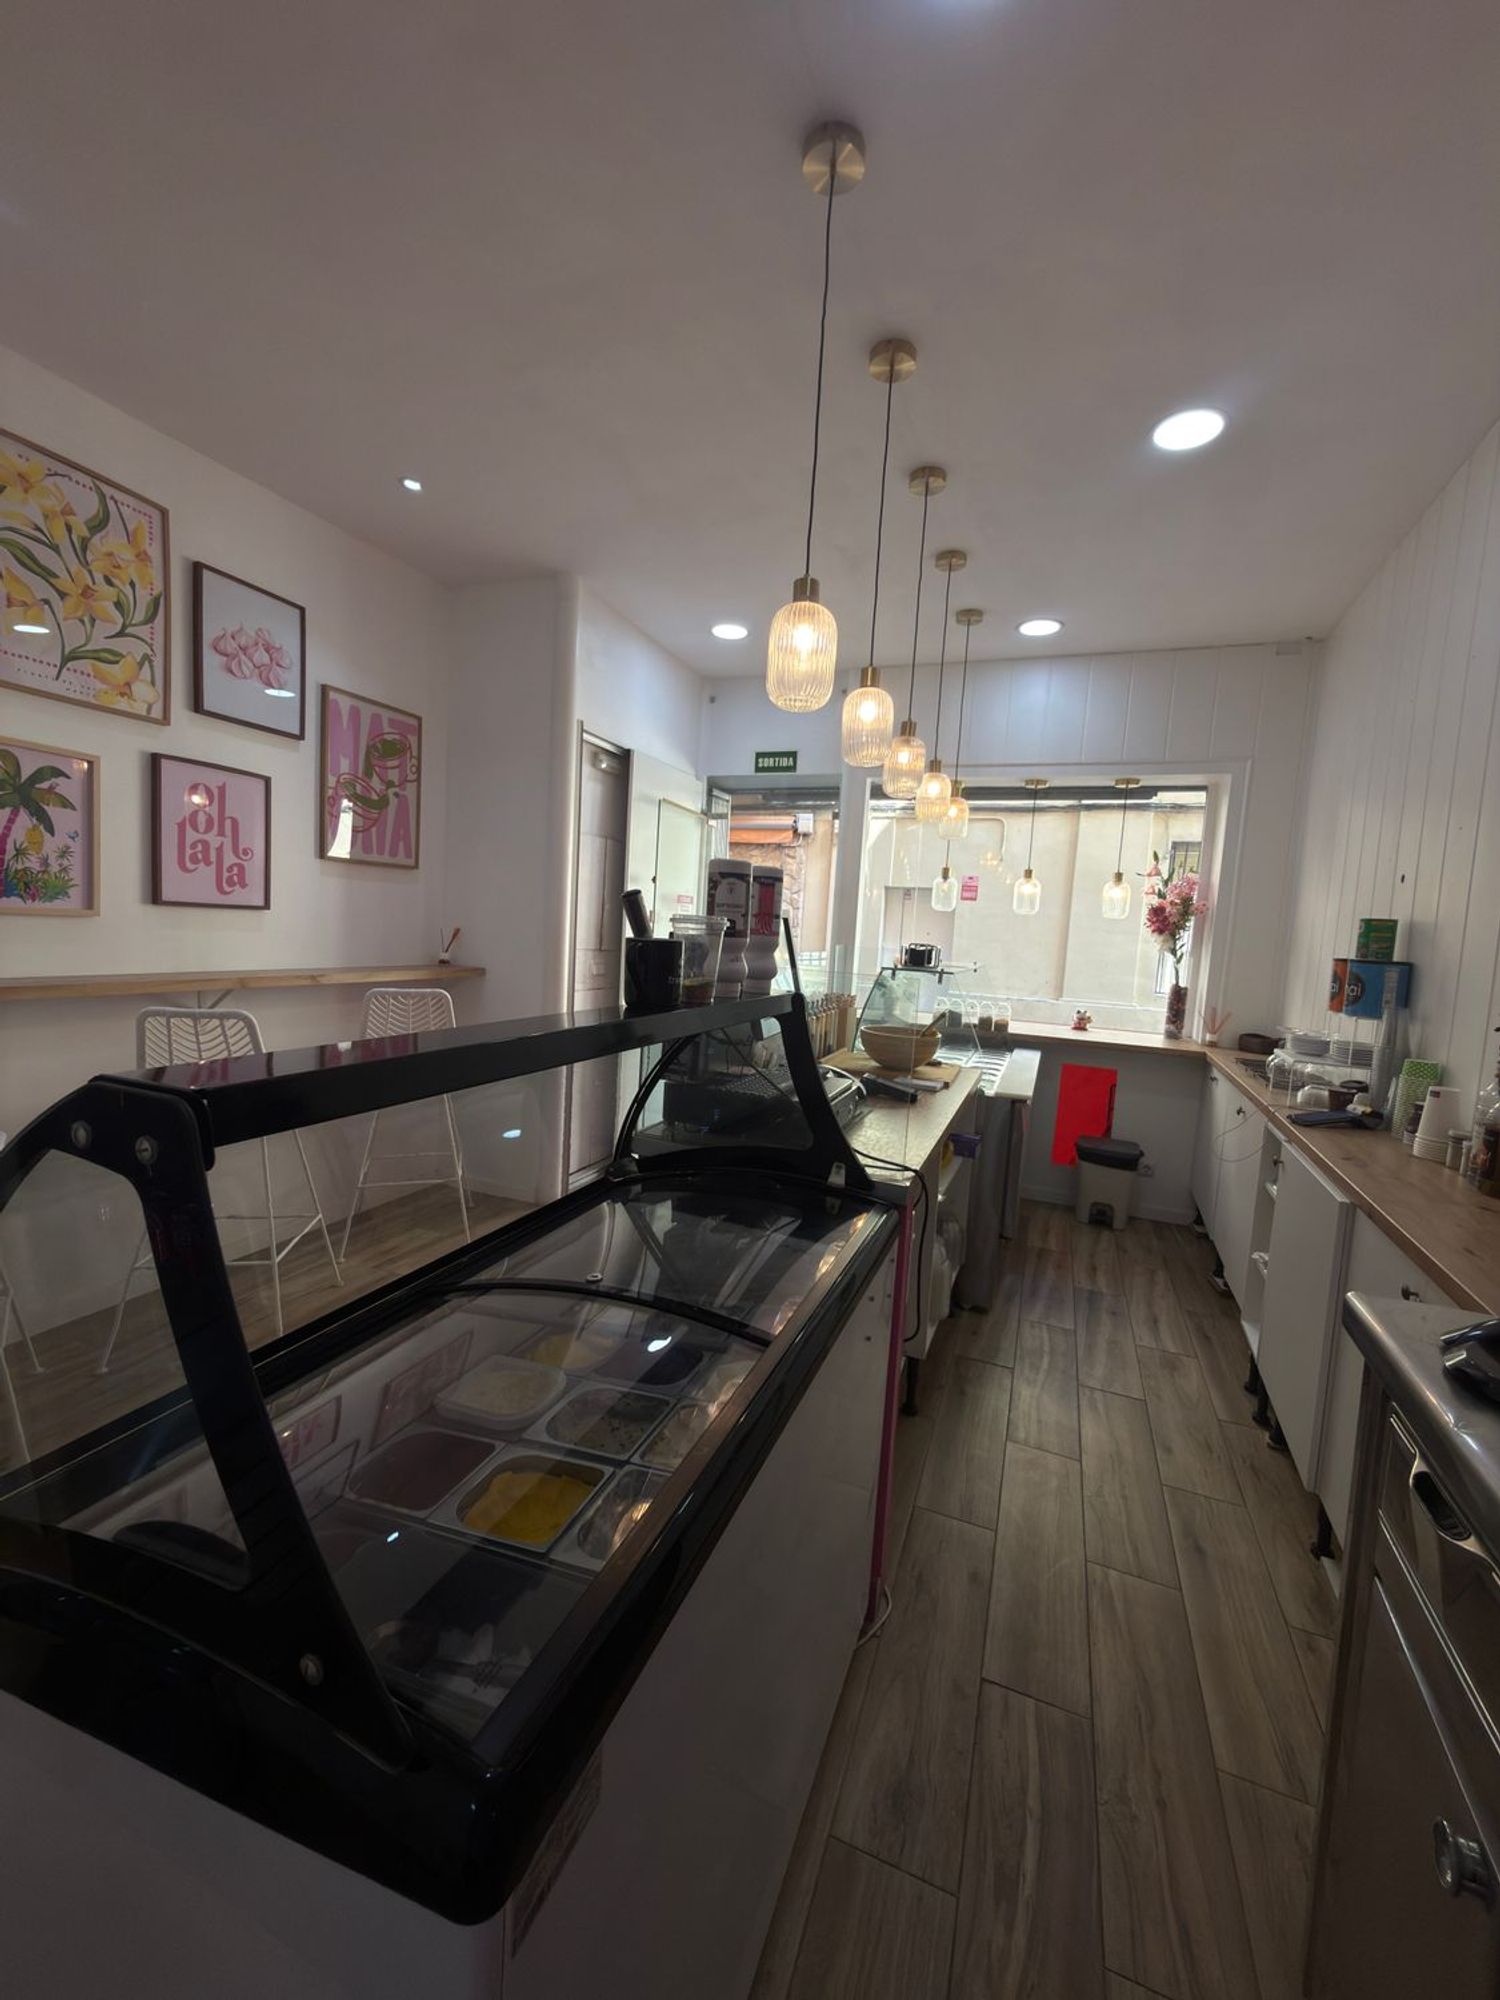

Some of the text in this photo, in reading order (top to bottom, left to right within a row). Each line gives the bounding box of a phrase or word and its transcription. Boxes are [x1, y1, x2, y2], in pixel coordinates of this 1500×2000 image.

[758, 757, 794, 767] SORTIDA
[175, 815, 248, 895] la la
